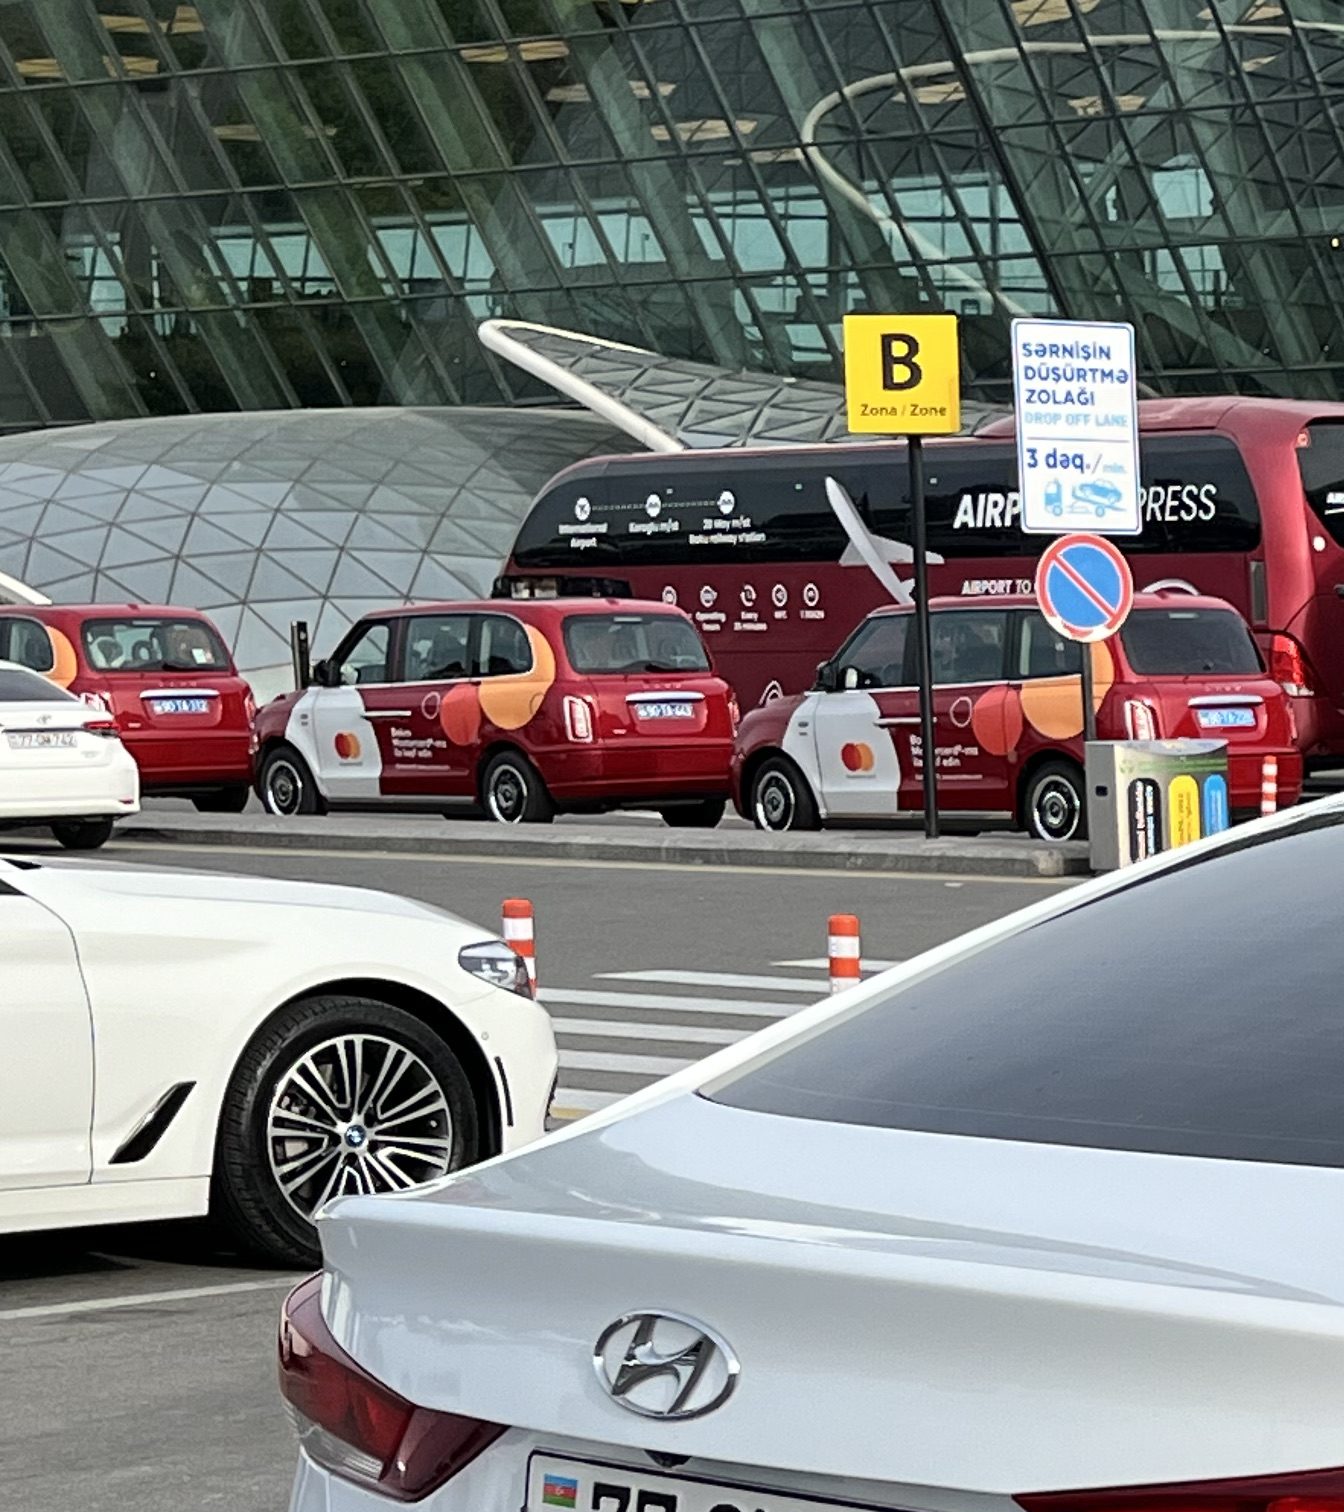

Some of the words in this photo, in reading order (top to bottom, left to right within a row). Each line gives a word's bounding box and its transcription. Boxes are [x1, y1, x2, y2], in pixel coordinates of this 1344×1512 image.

[1022, 340, 1111, 361] SƏRNİŞİN
[881, 333, 922, 392] B
[1024, 363, 1129, 385] DÜŞÜRTMƏ
[1025, 387, 1095, 407] ZOLAĞI
[860, 404, 897, 417] Zona
[910, 404, 947, 418] Zone
[1024, 412, 1062, 426] DROP
[1065, 413, 1091, 427] OFF
[1095, 414, 1129, 428] LANE
[1025, 449, 1039, 469] 3
[961, 580, 1012, 595] AIRPORT
[1015, 580, 1032, 594] TO
